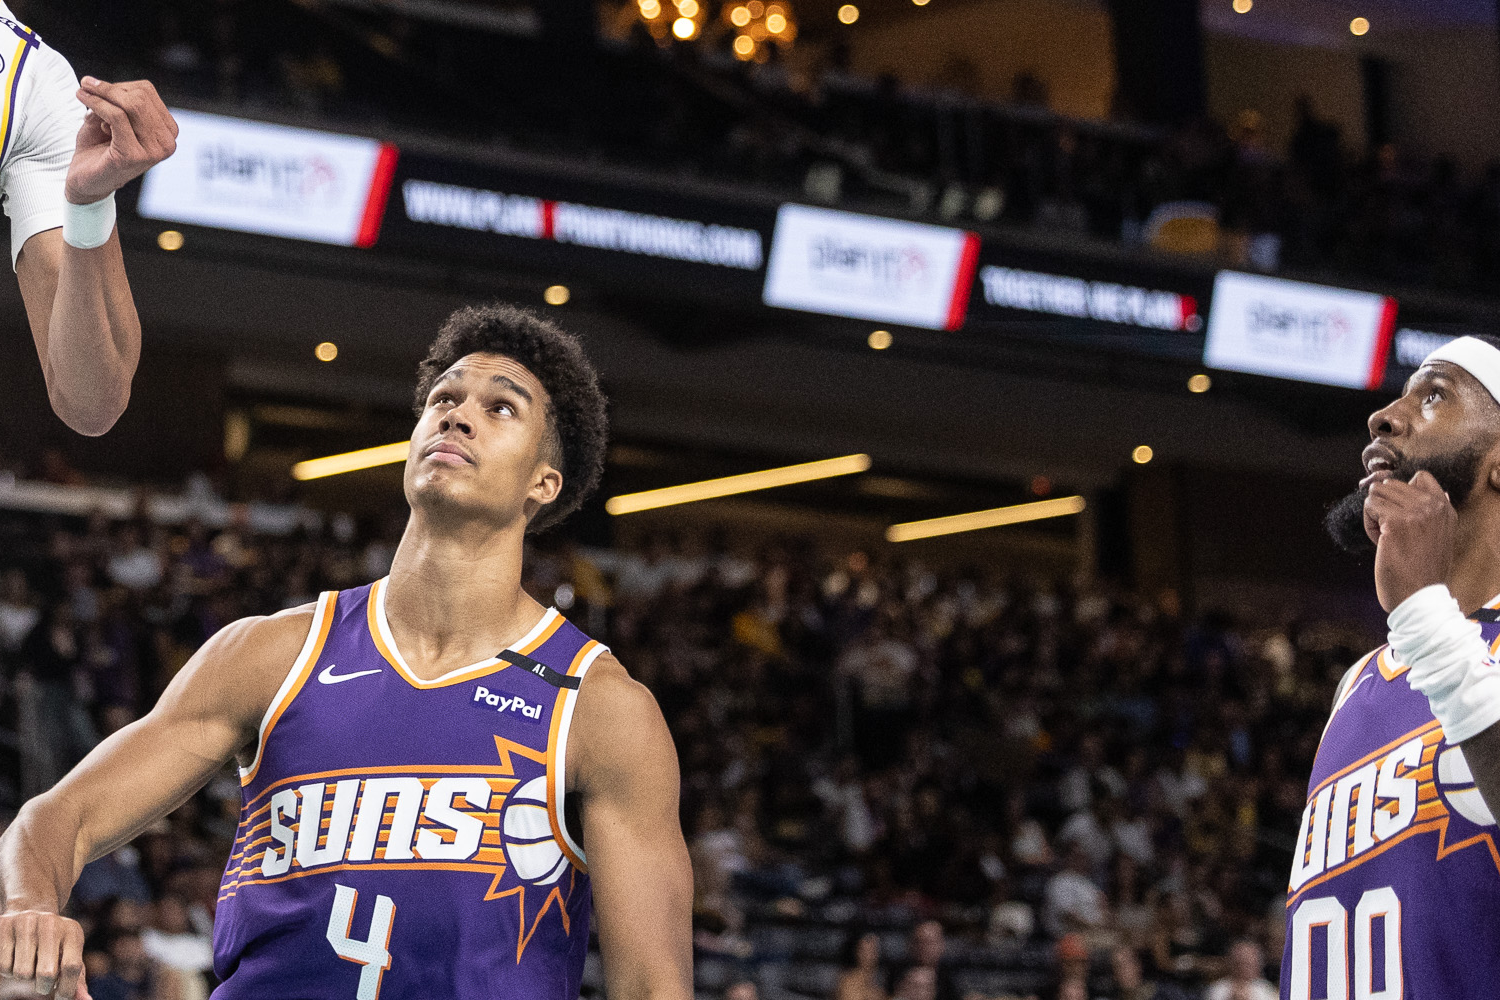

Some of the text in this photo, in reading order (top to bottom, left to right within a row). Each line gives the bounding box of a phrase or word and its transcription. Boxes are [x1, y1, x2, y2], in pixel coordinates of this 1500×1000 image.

[473, 685, 543, 720] PayPal
[531, 663, 547, 678] AL
[260, 777, 492, 878] SUNS
[1289, 736, 1424, 892] UNS
[326, 883, 397, 1000] 4
[1289, 885, 1404, 1000] 00
